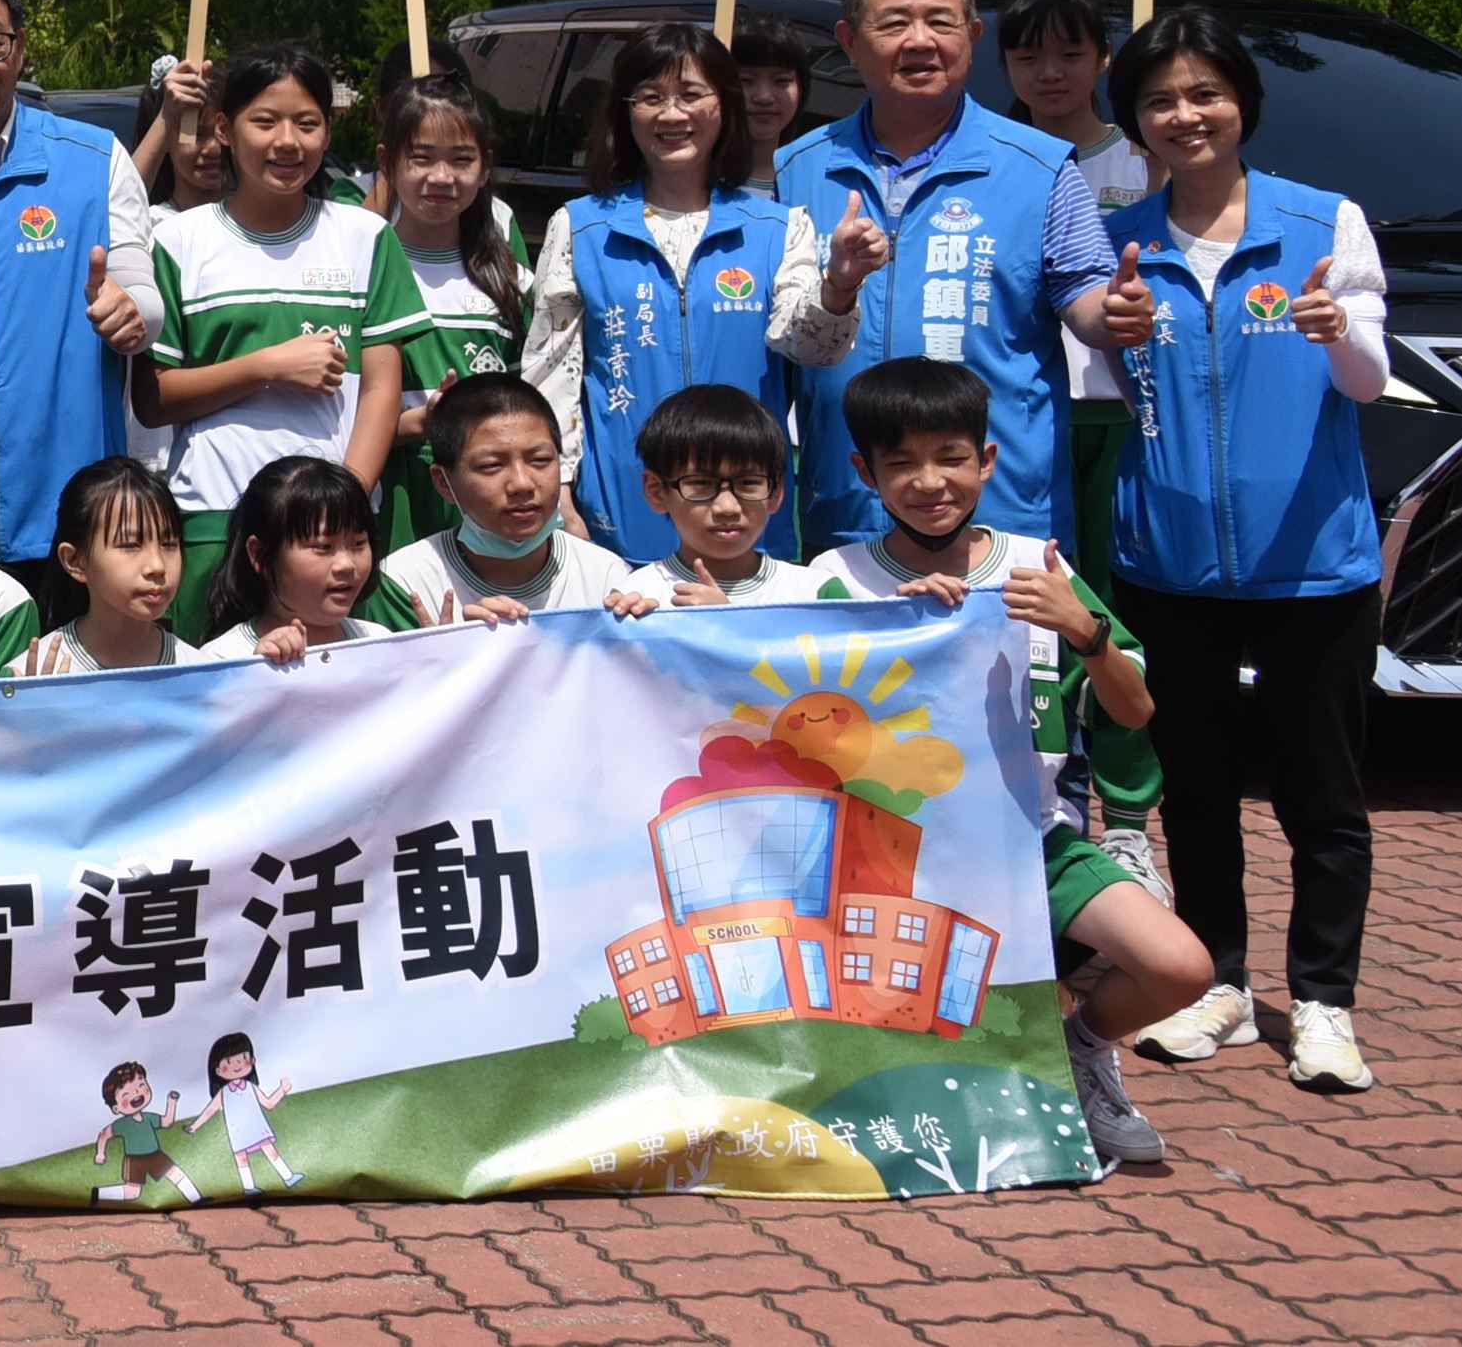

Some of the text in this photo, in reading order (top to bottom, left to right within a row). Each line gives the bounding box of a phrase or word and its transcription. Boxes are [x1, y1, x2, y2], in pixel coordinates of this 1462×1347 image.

[635, 282, 659, 348] 副局長
[921, 234, 970, 363] 邱鎮軍
[971, 234, 996, 327] 立法委員
[604, 304, 636, 416] 莊素玲
[1153, 301, 1178, 345] 處長
[707, 923, 761, 940] SCHOOL
